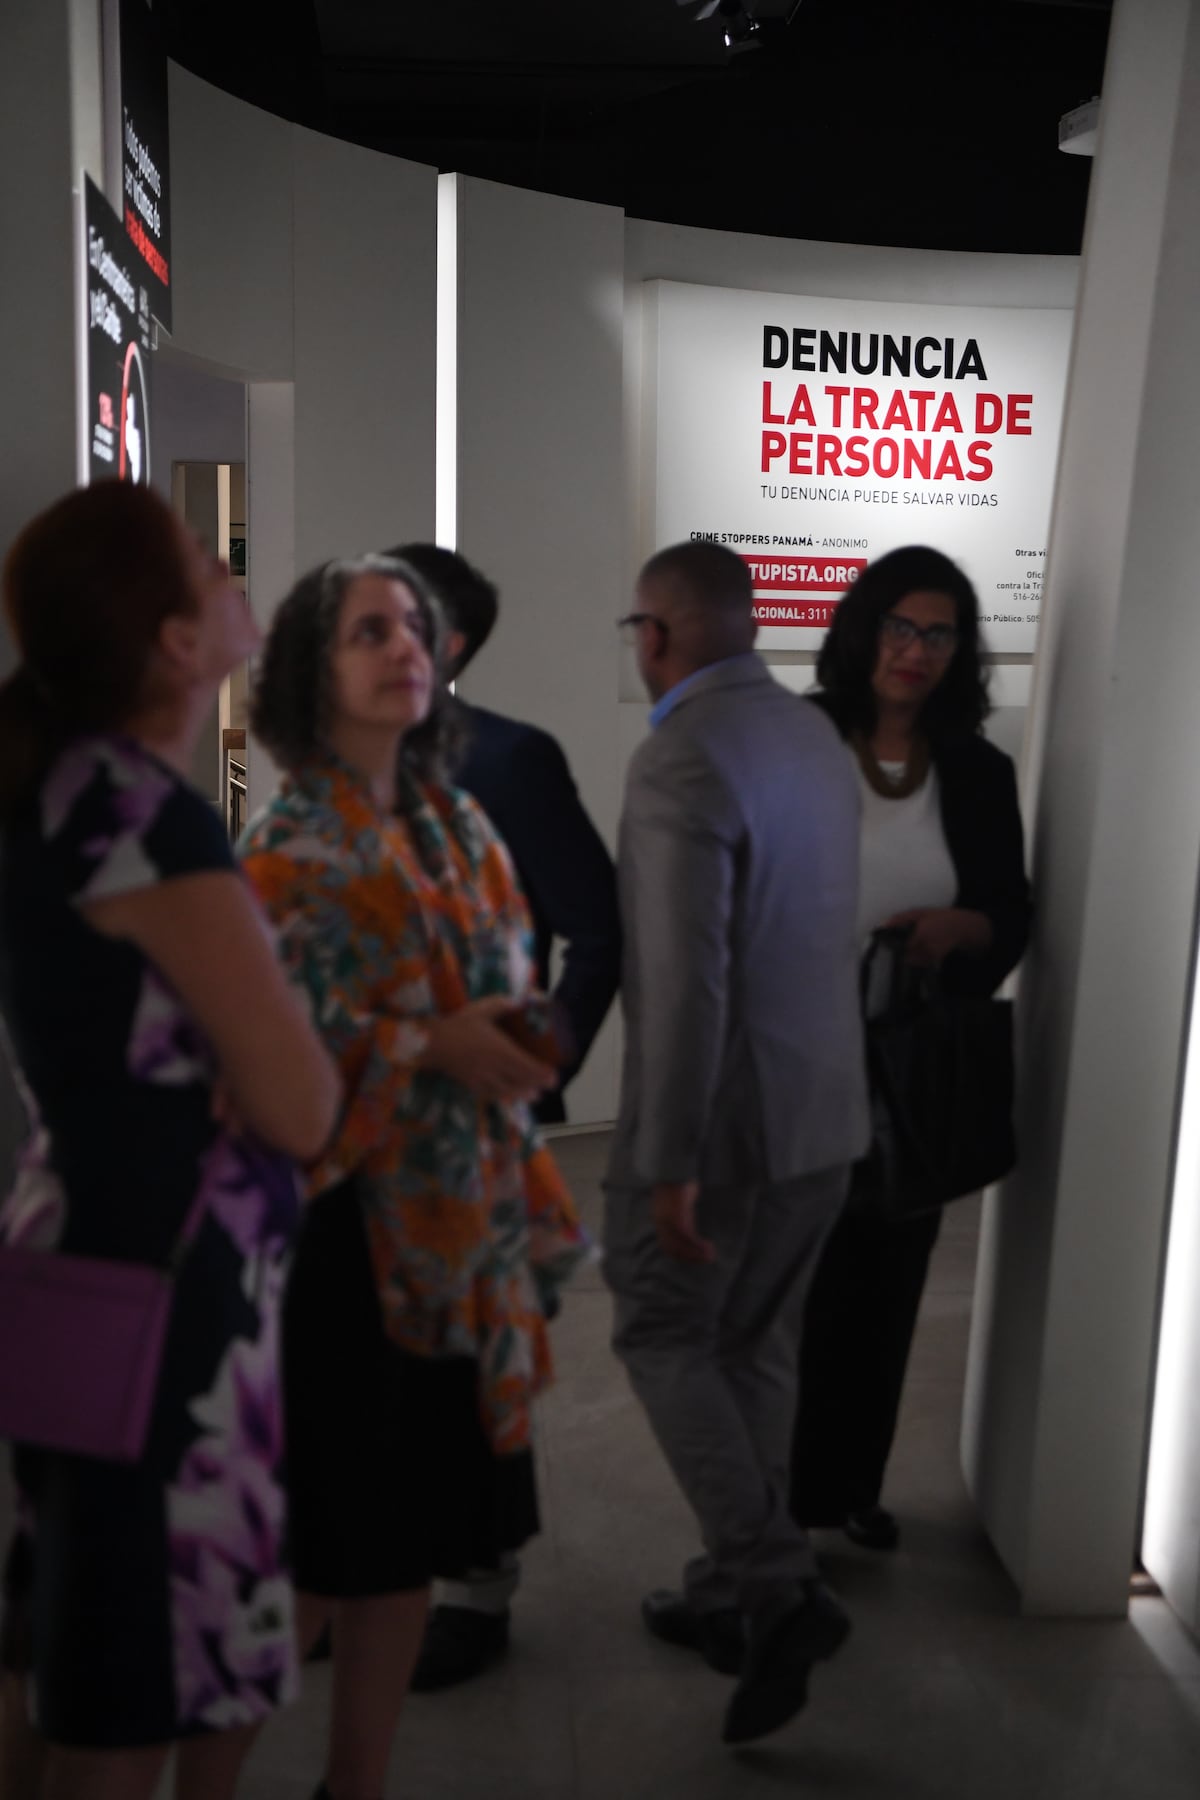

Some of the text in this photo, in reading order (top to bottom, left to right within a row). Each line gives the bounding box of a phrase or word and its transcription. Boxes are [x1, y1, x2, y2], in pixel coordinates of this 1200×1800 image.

[763, 325, 988, 380] DENUNCIA
[762, 381, 1033, 435] LA TRATA DE
[761, 430, 993, 482] PERSONAS
[760, 485, 998, 507] TU DENUNCIA PUEDE SALVAR VIDAS
[690, 531, 719, 543] CRIME
[721, 533, 770, 545] STOPPERS
[772, 534, 813, 547] PANAMÁ
[822, 538, 868, 549] ANONIMO
[1015, 549, 1037, 557] Otras
[1026, 571, 1046, 579] Ofici
[1013, 592, 1043, 601] 516-26
[750, 606, 805, 620] ACIONAL:
[808, 608, 827, 620] 311
